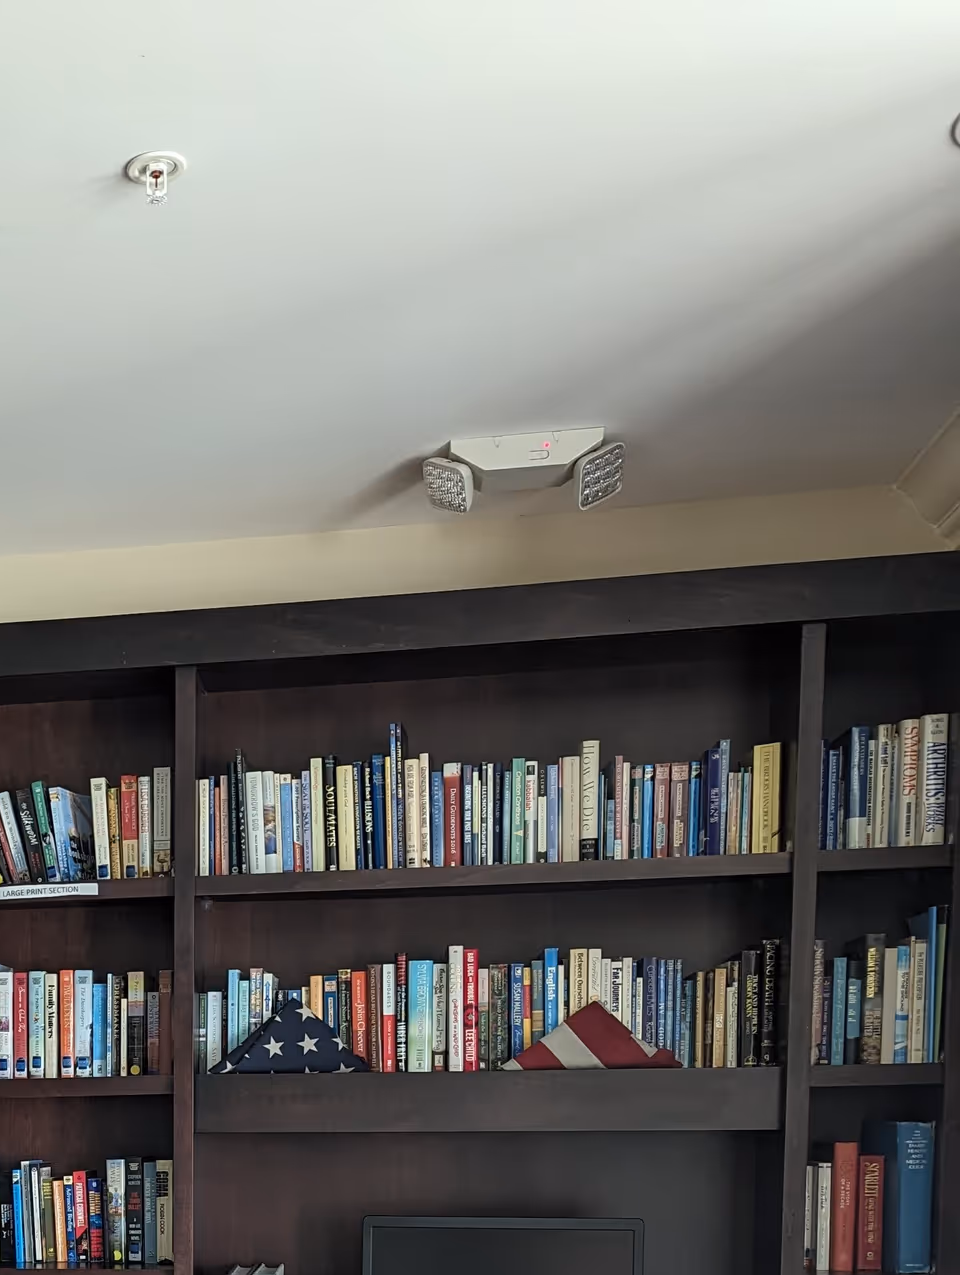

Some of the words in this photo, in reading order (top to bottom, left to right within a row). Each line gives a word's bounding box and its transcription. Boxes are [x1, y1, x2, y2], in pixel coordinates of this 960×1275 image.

[582, 745, 595, 775] How
[902, 726, 919, 797] SYMPTOMS
[925, 741, 947, 801] ARTHRITIS:
[302, 783, 310, 801] SEAT
[449, 788, 457, 804] DAILY
[525, 779, 533, 812] kabbalah
[582, 780, 596, 802] We
[1, 797, 9, 810] sold
[252, 818, 260, 832] GOD
[303, 812, 311, 834] SOUL
[364, 800, 373, 832] ILLUSIONS
[583, 807, 596, 832] Die
[2, 889, 25, 898] LARGE
[26, 887, 48, 896] PRINT
[48, 885, 79, 894] SECTION
[765, 945, 775, 975] FACING
[417, 965, 426, 984] SYLVIA
[547, 967, 556, 1001] English
[612, 967, 622, 980] FAR
[47, 984, 56, 1010] Family
[417, 986, 426, 1013] BROWNE
[513, 982, 521, 1001] SUSAN
[611, 980, 622, 1013] JOURNEYS
[764, 978, 774, 1006] DEATH
[355, 1003, 365, 1021] John
[513, 1002, 521, 1026] MALLERY
[17, 1023, 26, 1033] Key
[47, 1011, 55, 1039] Matters
[357, 1022, 365, 1052] Cheever
[465, 1029, 474, 1040] LEE
[645, 1021, 655, 1042] Richard
[465, 1041, 475, 1062] CHILD
[75, 1182, 84, 1202] PATRICIA
[156, 1171, 169, 1197] COMA
[864, 1162, 880, 1198] SCARLETT
[66, 1213, 74, 1232] Birding
[76, 1203, 85, 1227] CORNWELL
